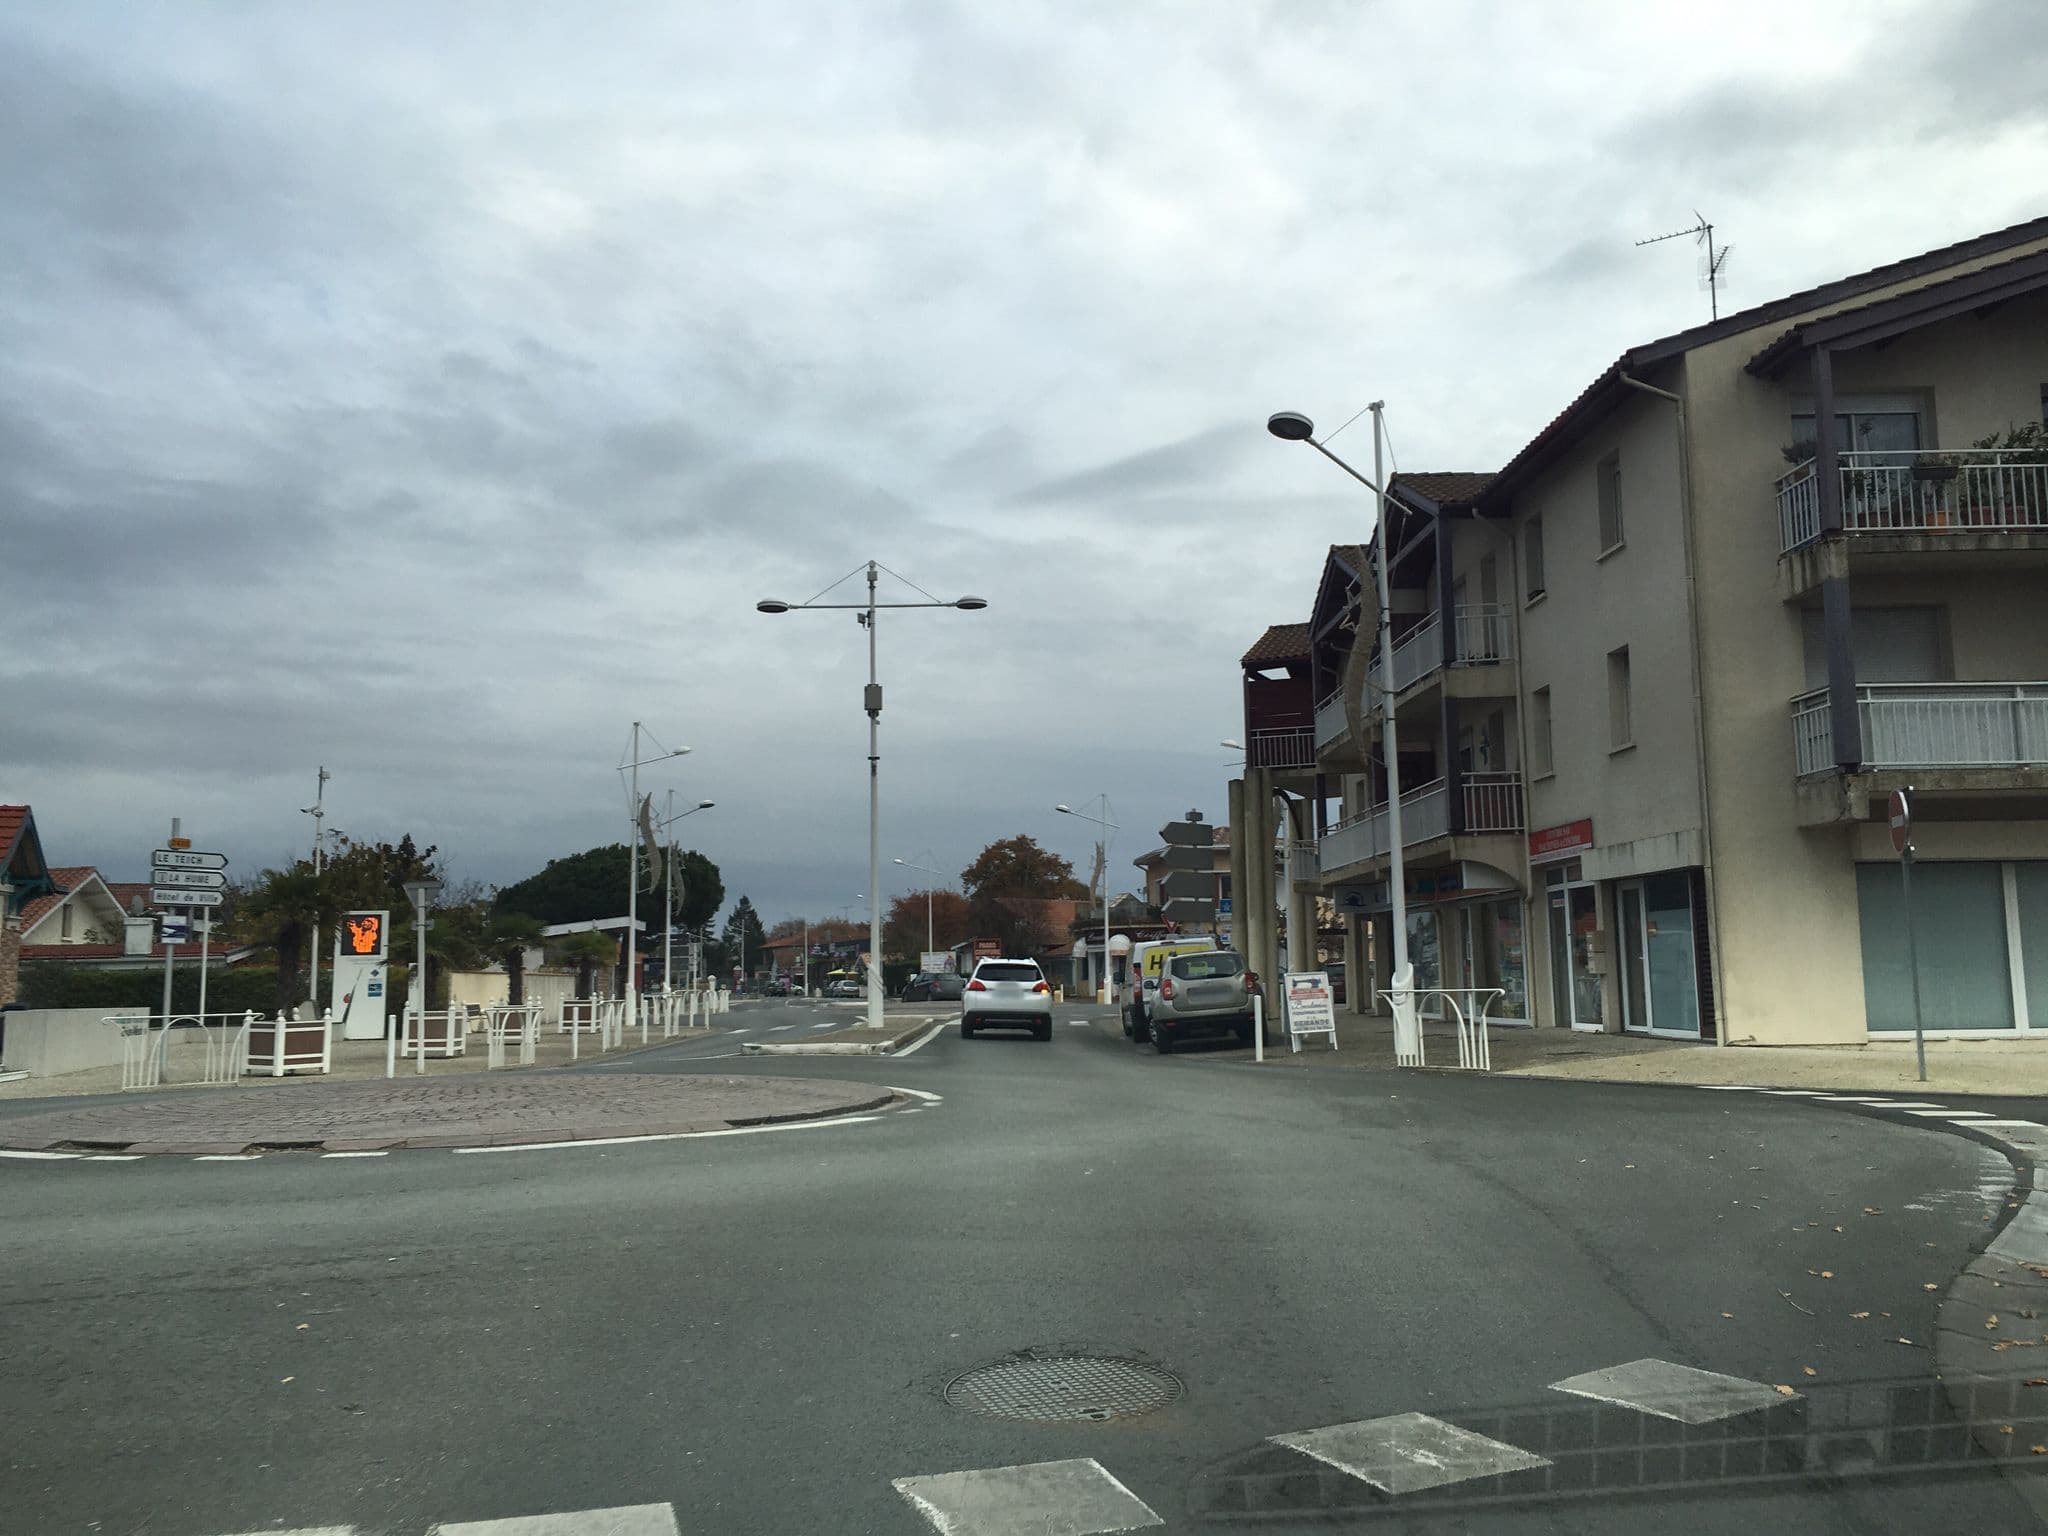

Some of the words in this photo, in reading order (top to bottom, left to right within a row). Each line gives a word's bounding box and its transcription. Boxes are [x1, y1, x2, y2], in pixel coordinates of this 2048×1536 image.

[157, 854, 169, 863] LE
[175, 855, 203, 864] TEICH
[169, 874, 179, 882] LA
[185, 874, 210, 884] HUME
[183, 893, 194, 902] de
